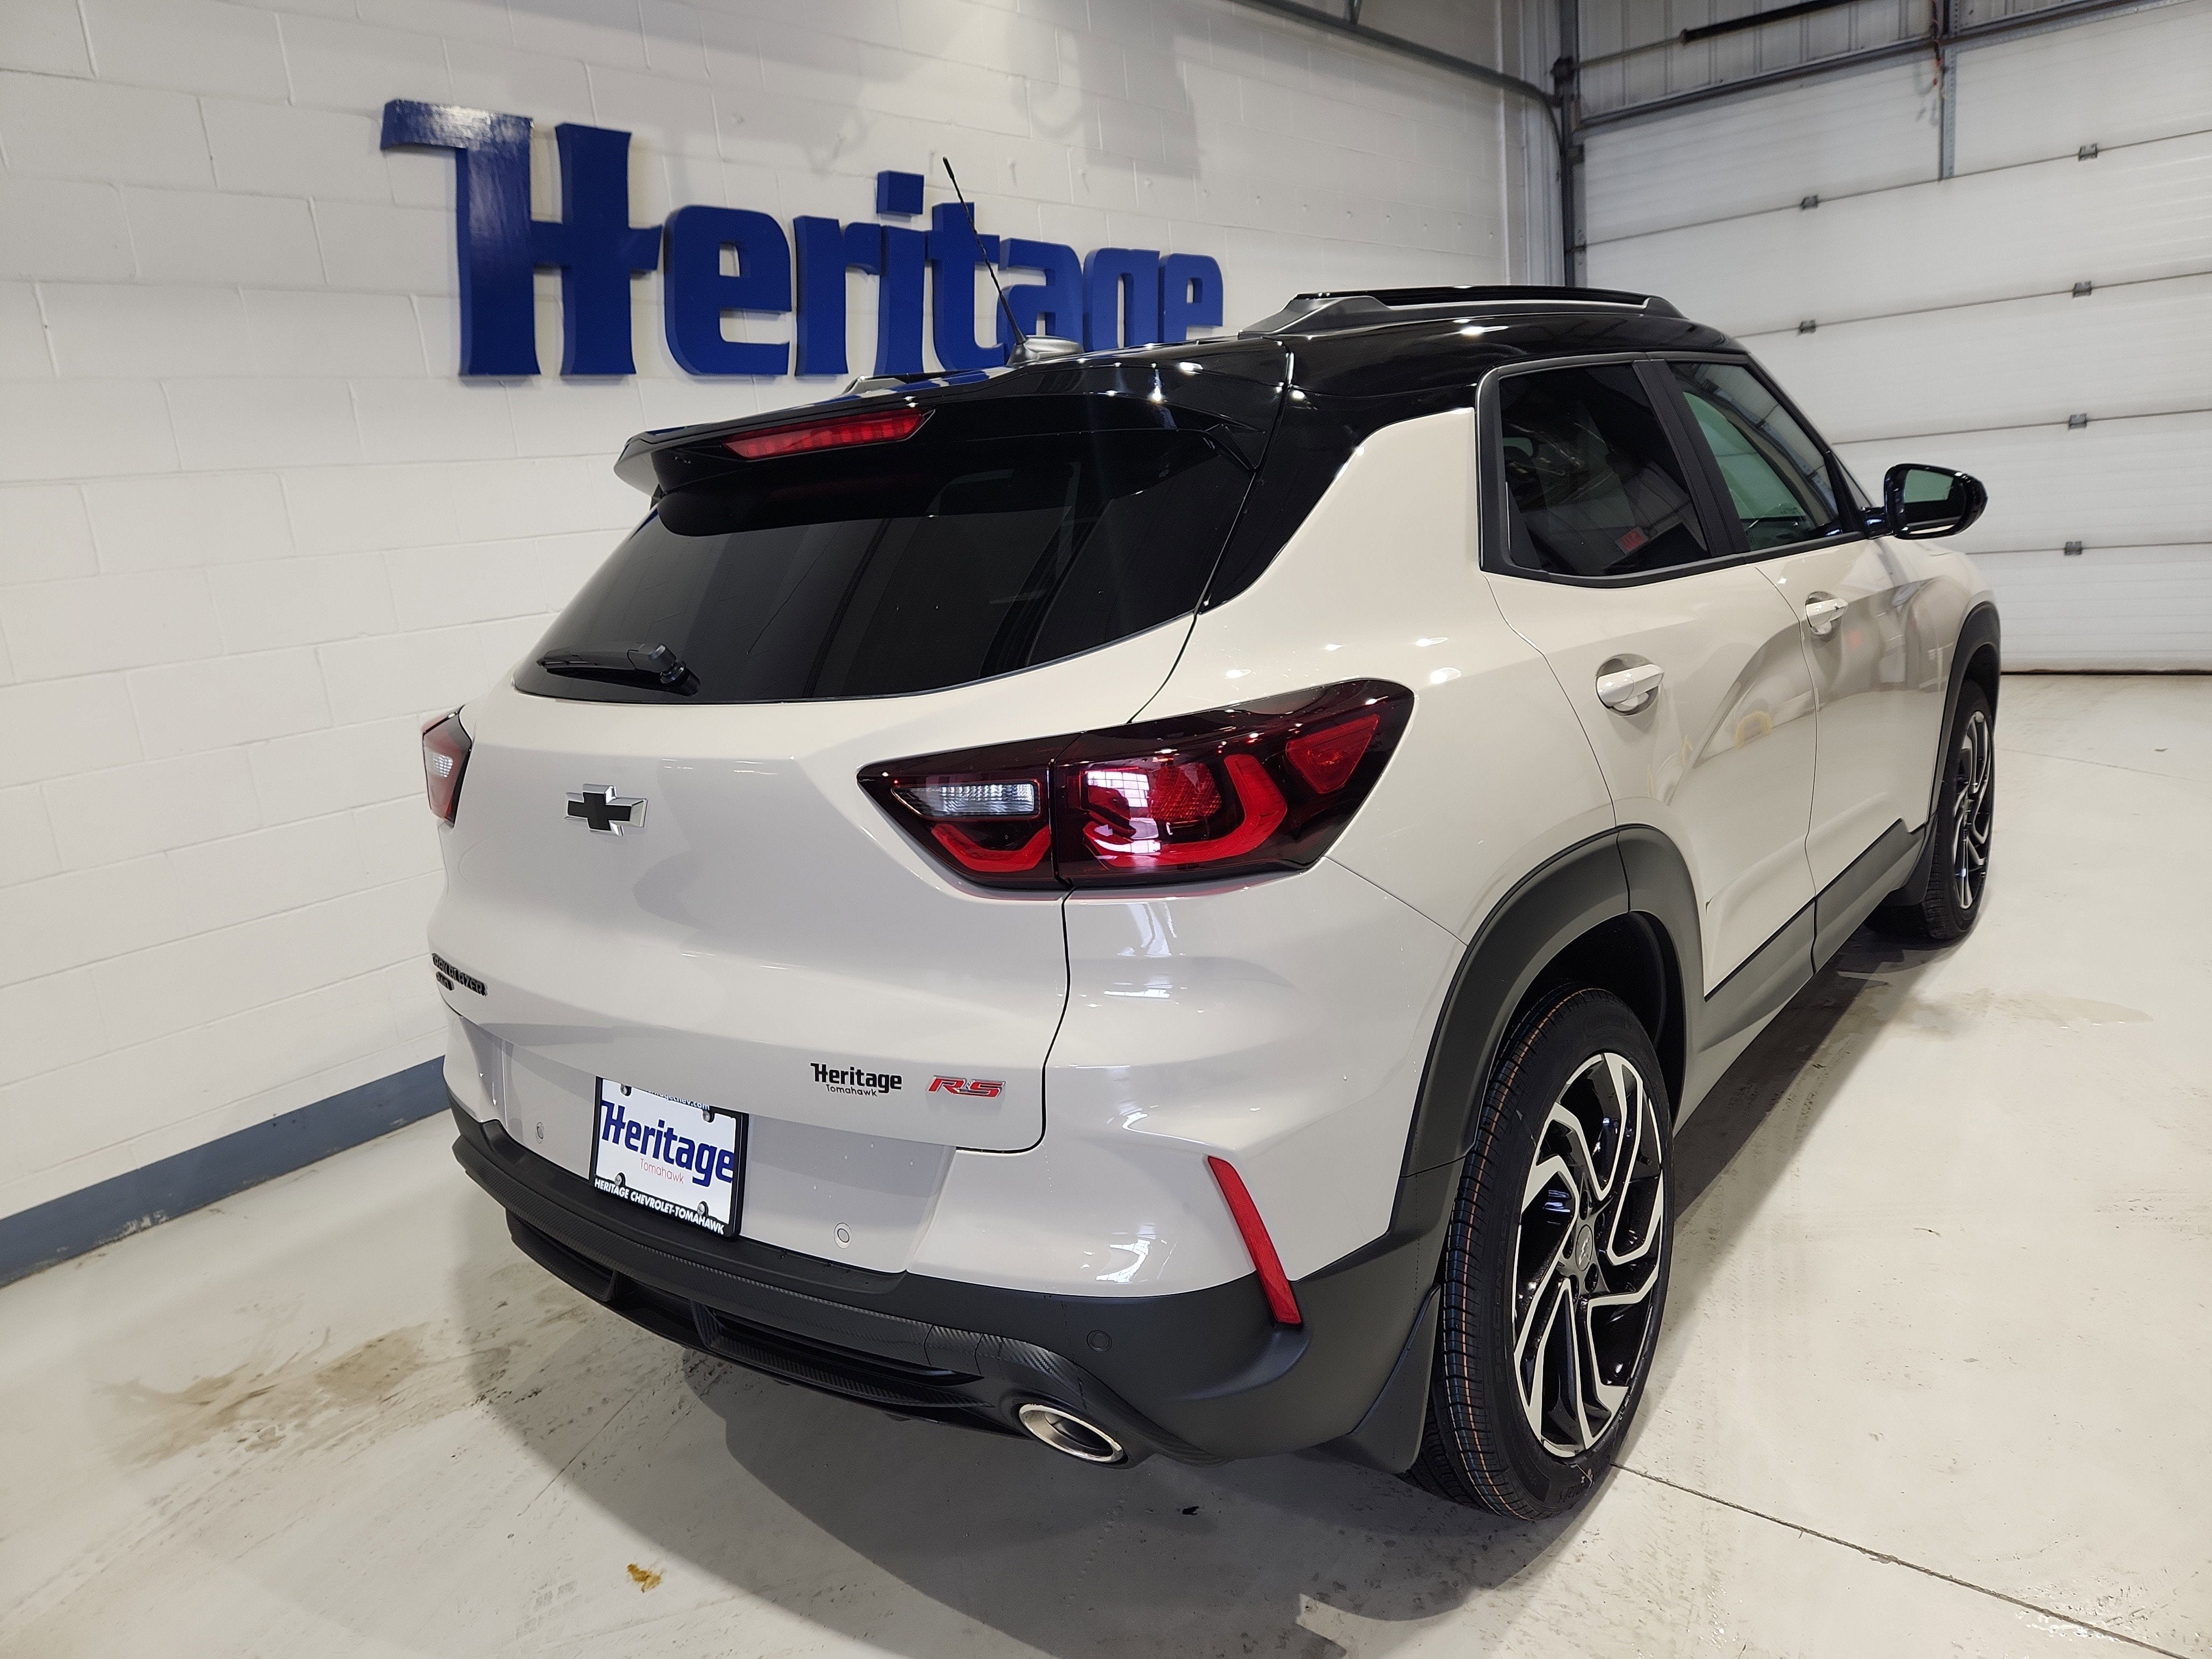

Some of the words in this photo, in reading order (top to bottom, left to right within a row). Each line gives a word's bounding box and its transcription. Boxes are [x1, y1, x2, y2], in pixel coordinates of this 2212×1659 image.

[380, 99, 1224, 377] Heritage
[810, 1062, 903, 1094] Heritage
[825, 1084, 878, 1097] Tomahawk
[927, 1075, 1007, 1098] RS
[601, 1099, 735, 1187] Heritage
[640, 1158, 684, 1184] Tomahawk
[594, 1178, 629, 1200] HERITAGE
[630, 1191, 725, 1236] CHEVROLET-TOMAHAWK
